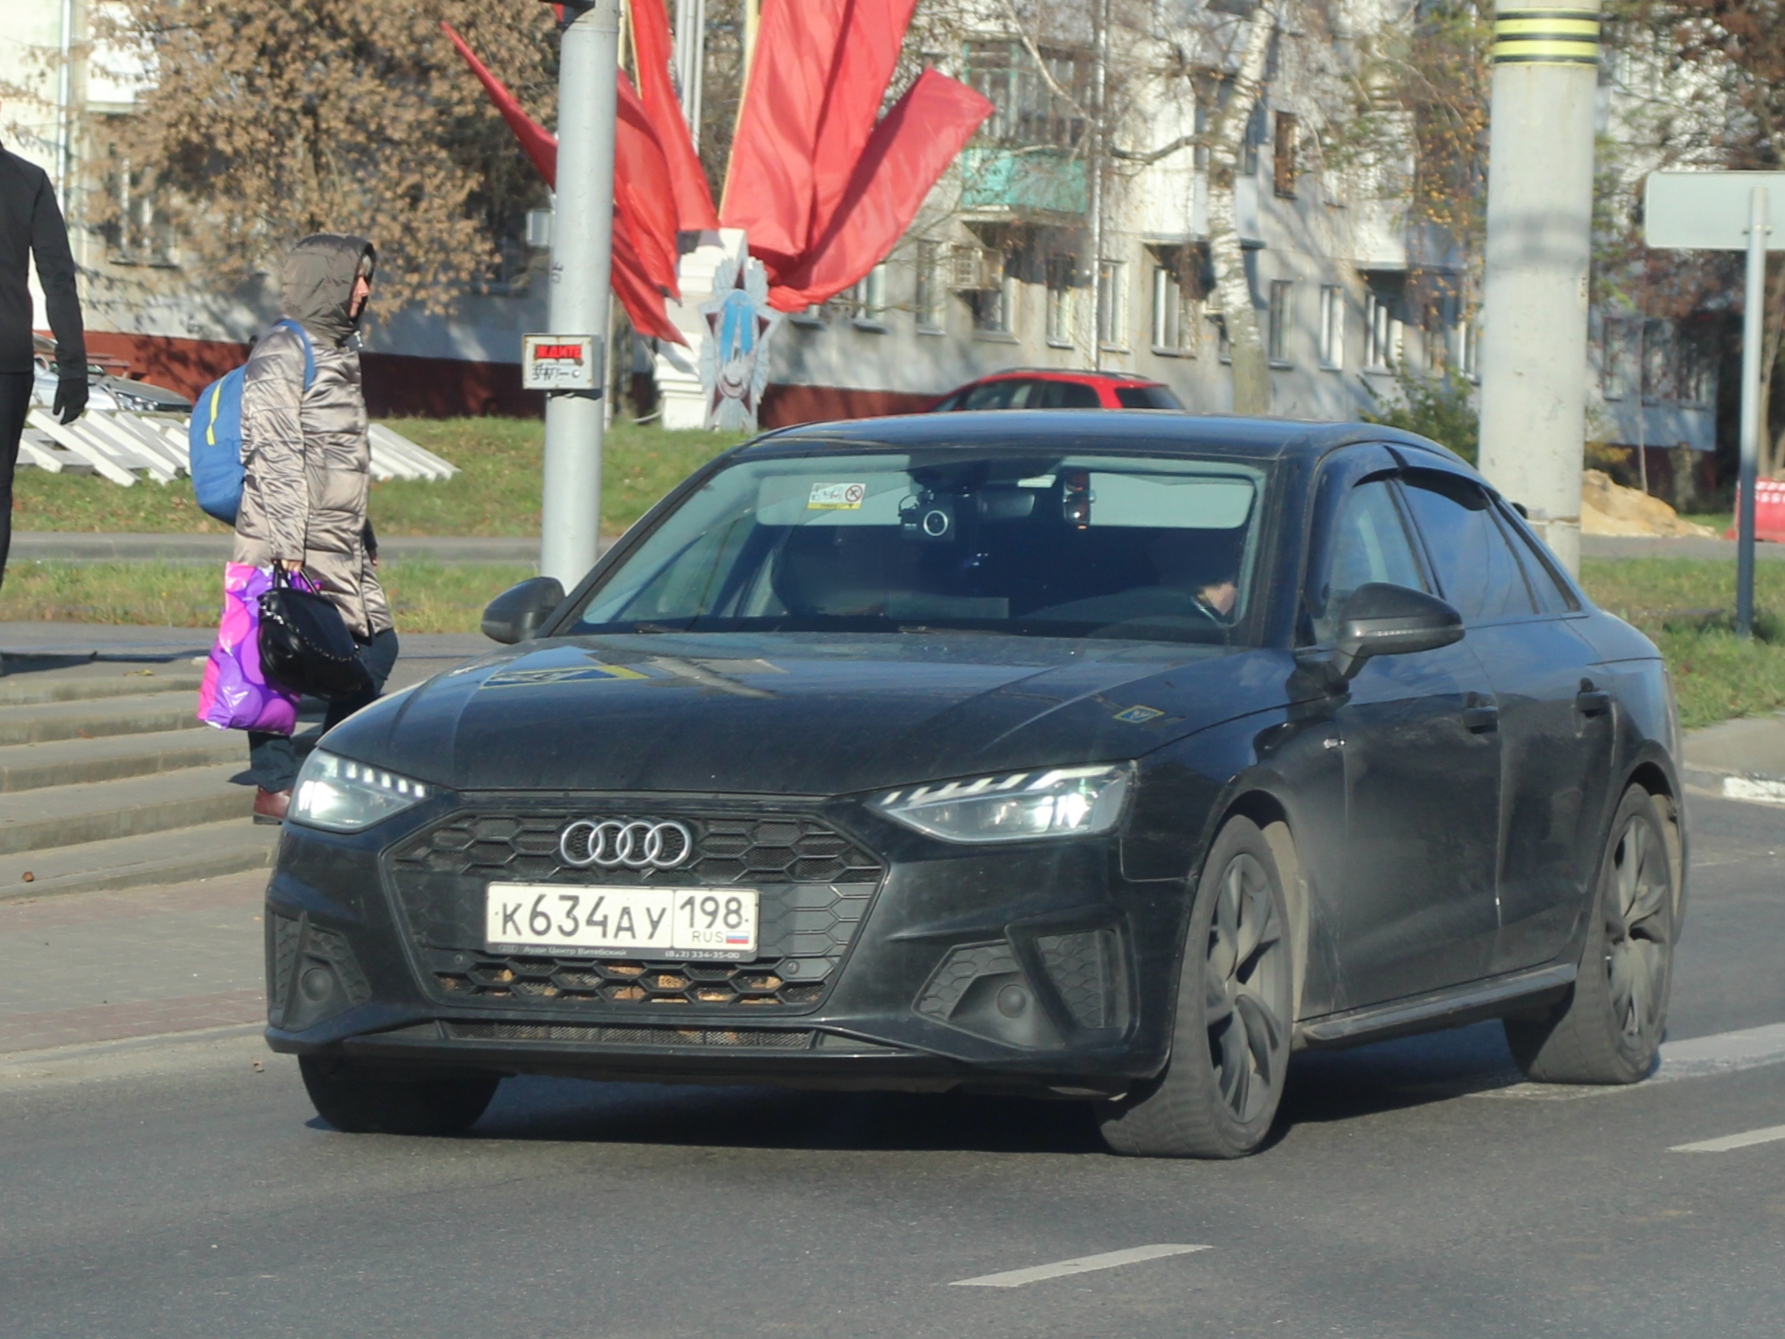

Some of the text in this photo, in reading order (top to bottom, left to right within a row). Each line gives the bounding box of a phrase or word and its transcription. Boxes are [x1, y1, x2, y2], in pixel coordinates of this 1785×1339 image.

[502, 894, 743, 940] К634АУ 198
[691, 930, 724, 943] RUS
[523, 945, 627, 957] Ауди Центр Витебский
